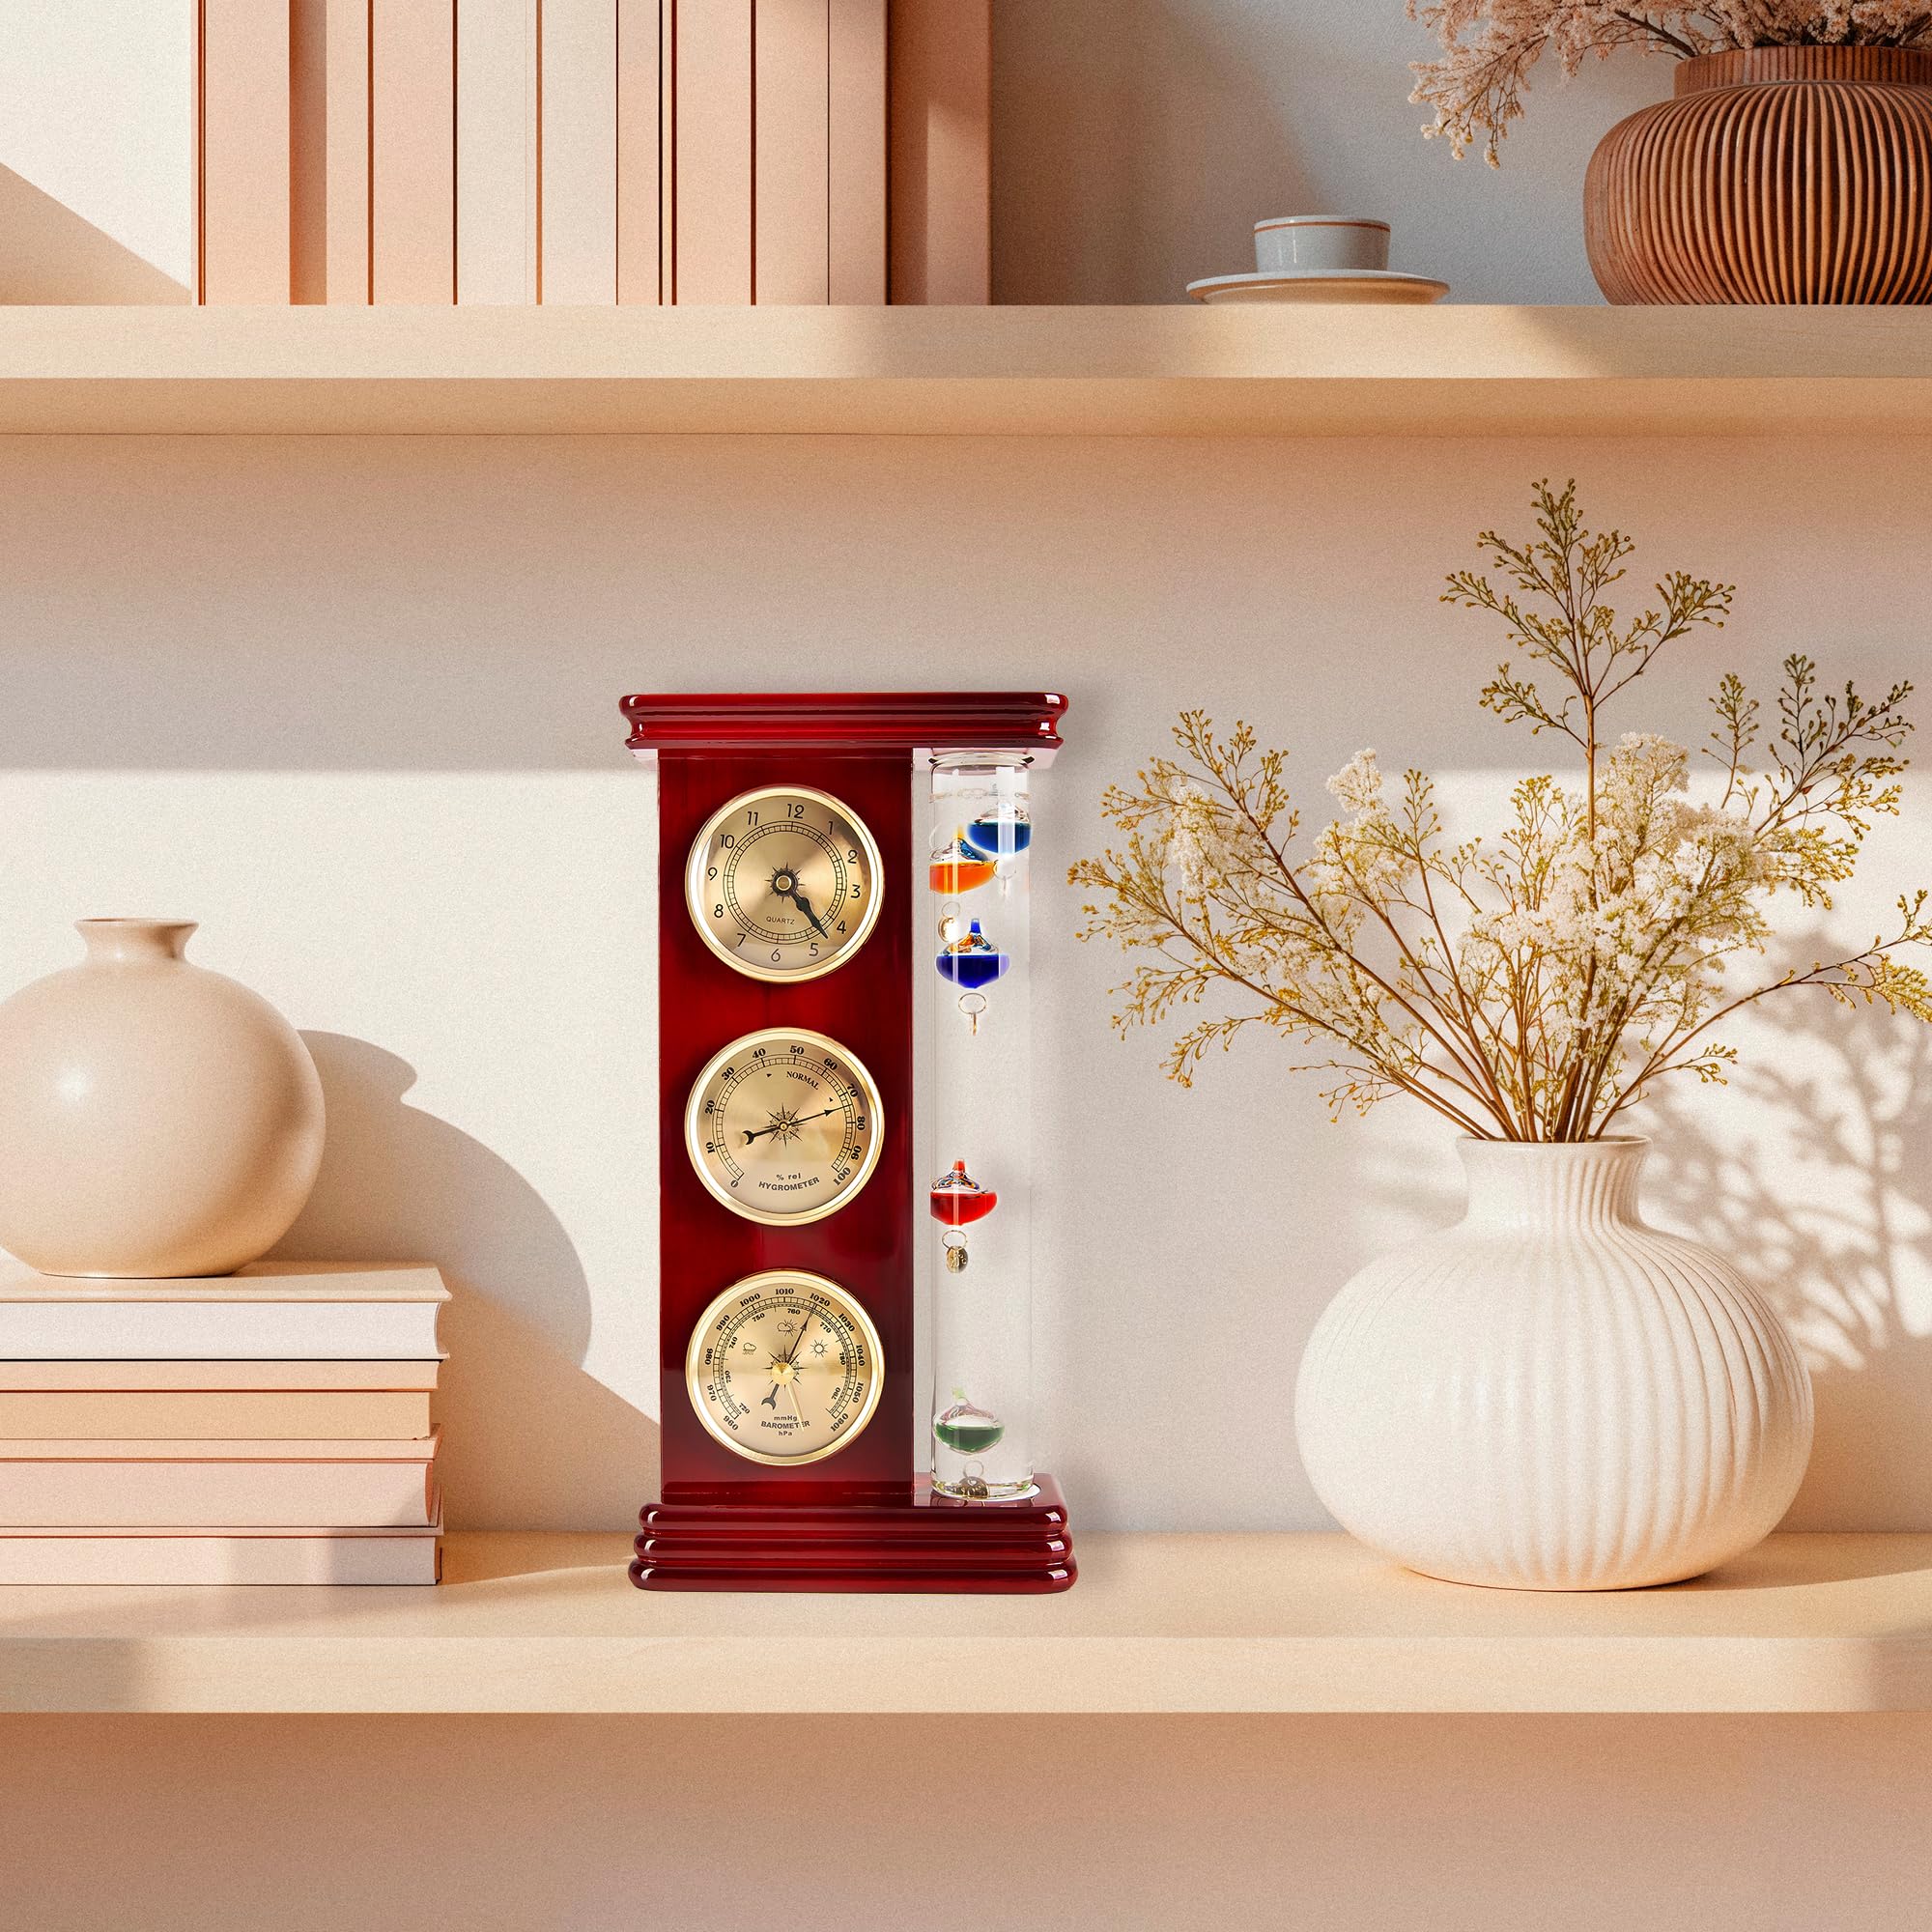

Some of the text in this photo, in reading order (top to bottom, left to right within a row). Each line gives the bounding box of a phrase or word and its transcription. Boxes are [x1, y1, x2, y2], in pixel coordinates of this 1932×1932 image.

[787, 804, 804, 818] 12
[748, 811, 758, 825] 11
[829, 821, 833, 835] 1
[721, 835, 734, 848] 10
[848, 850, 857, 864] 2
[708, 867, 717, 880] 9
[851, 885, 860, 898] 3
[714, 904, 724, 918] 8
[837, 921, 846, 934] 4
[737, 933, 746, 947] 7
[771, 949, 781, 962] 6
[810, 943, 818, 956] 5
[753, 1048, 766, 1059] 40
[790, 1046, 804, 1055] 50
[824, 1058, 838, 1070] 60
[722, 1067, 735, 1080] 30
[786, 1071, 818, 1090] NORMAL
[847, 1084, 858, 1097] 70
[705, 1100, 715, 1114] 20
[858, 1117, 866, 1130] 80
[707, 1142, 715, 1153] 10
[851, 1146, 862, 1159] 90
[834, 1167, 850, 1185] 100
[759, 1178, 819, 1191] HYGROMETER
[740, 1293, 760, 1306] 1000
[810, 1293, 830, 1306] 1020
[716, 1315, 729, 1331] 990
[753, 1313, 765, 1321] 750
[838, 1313, 855, 1332] 1030
[820, 1322, 831, 1333] 770
[857, 1345, 866, 1366] 1040
[707, 1385, 716, 1401] 970
[853, 1382, 864, 1403] 1050
[724, 1415, 738, 1431] 960
[831, 1413, 848, 1432] 1060
